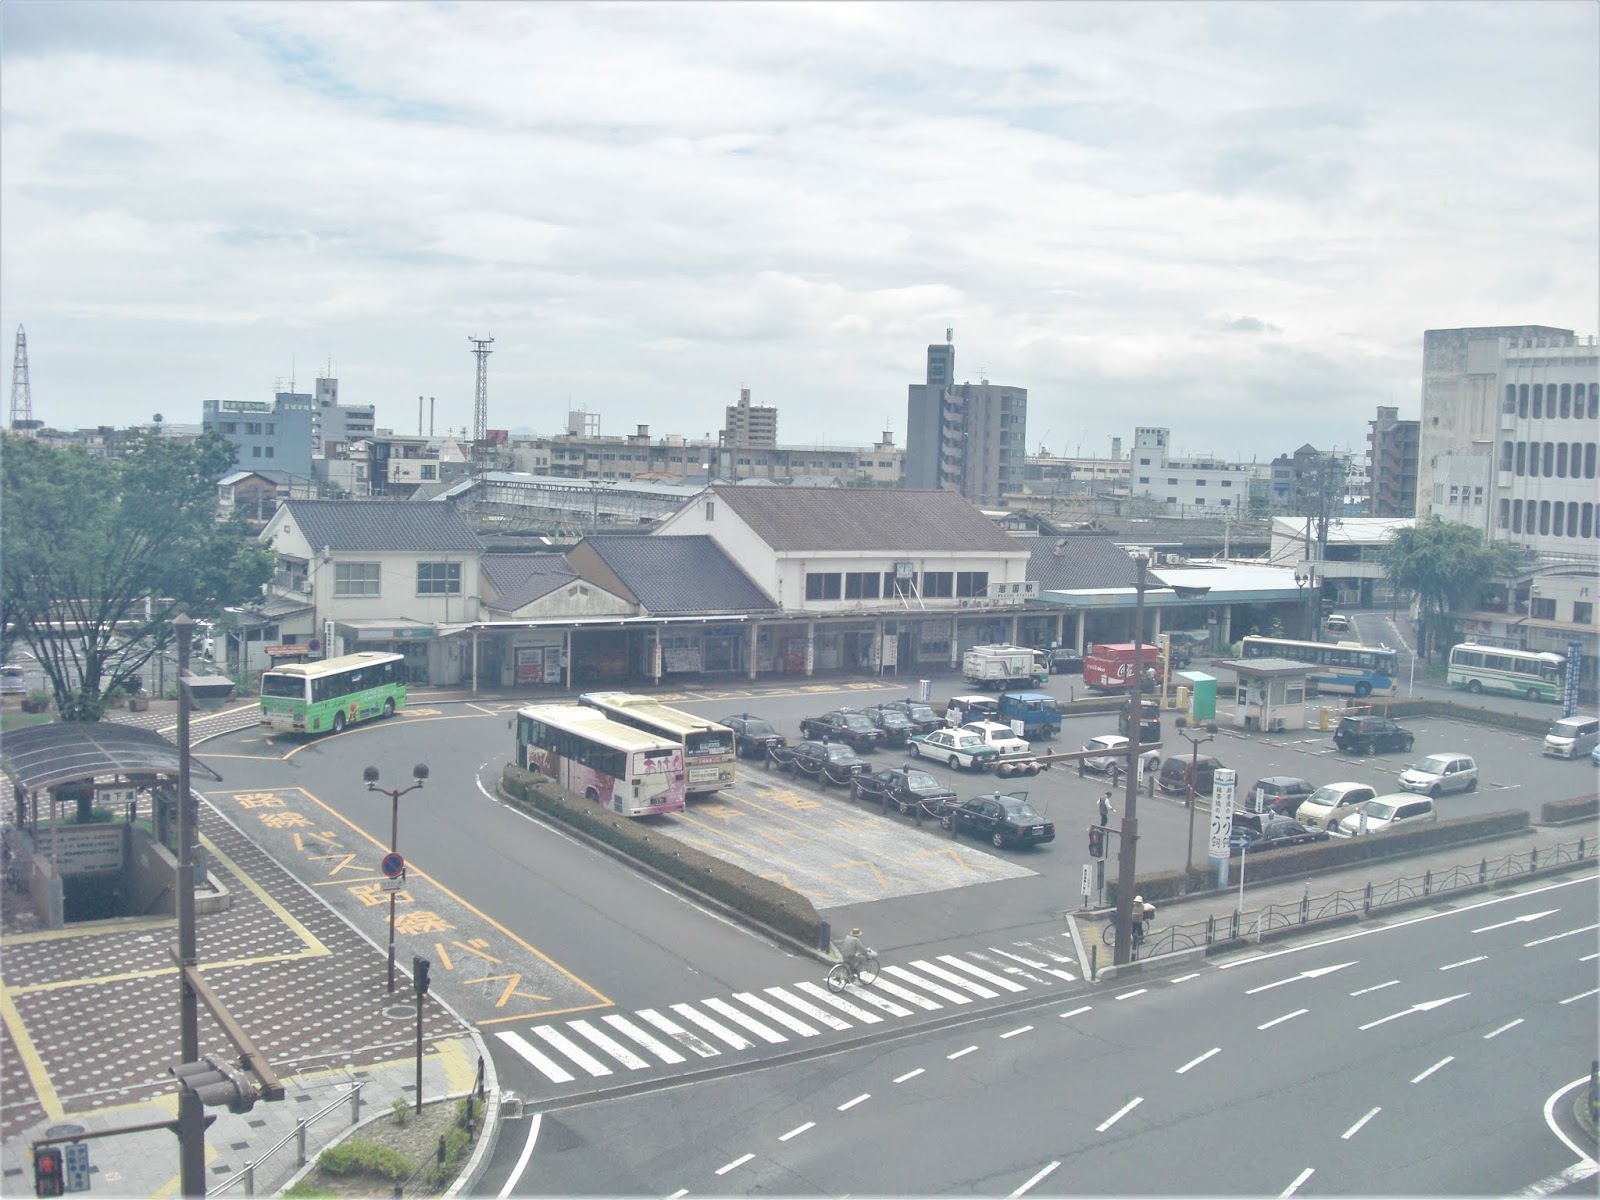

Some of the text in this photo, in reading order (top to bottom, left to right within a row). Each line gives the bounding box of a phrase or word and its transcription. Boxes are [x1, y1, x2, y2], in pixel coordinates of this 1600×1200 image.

[233, 793, 375, 875] 路線バス
[347, 883, 552, 1007] 路線バス
